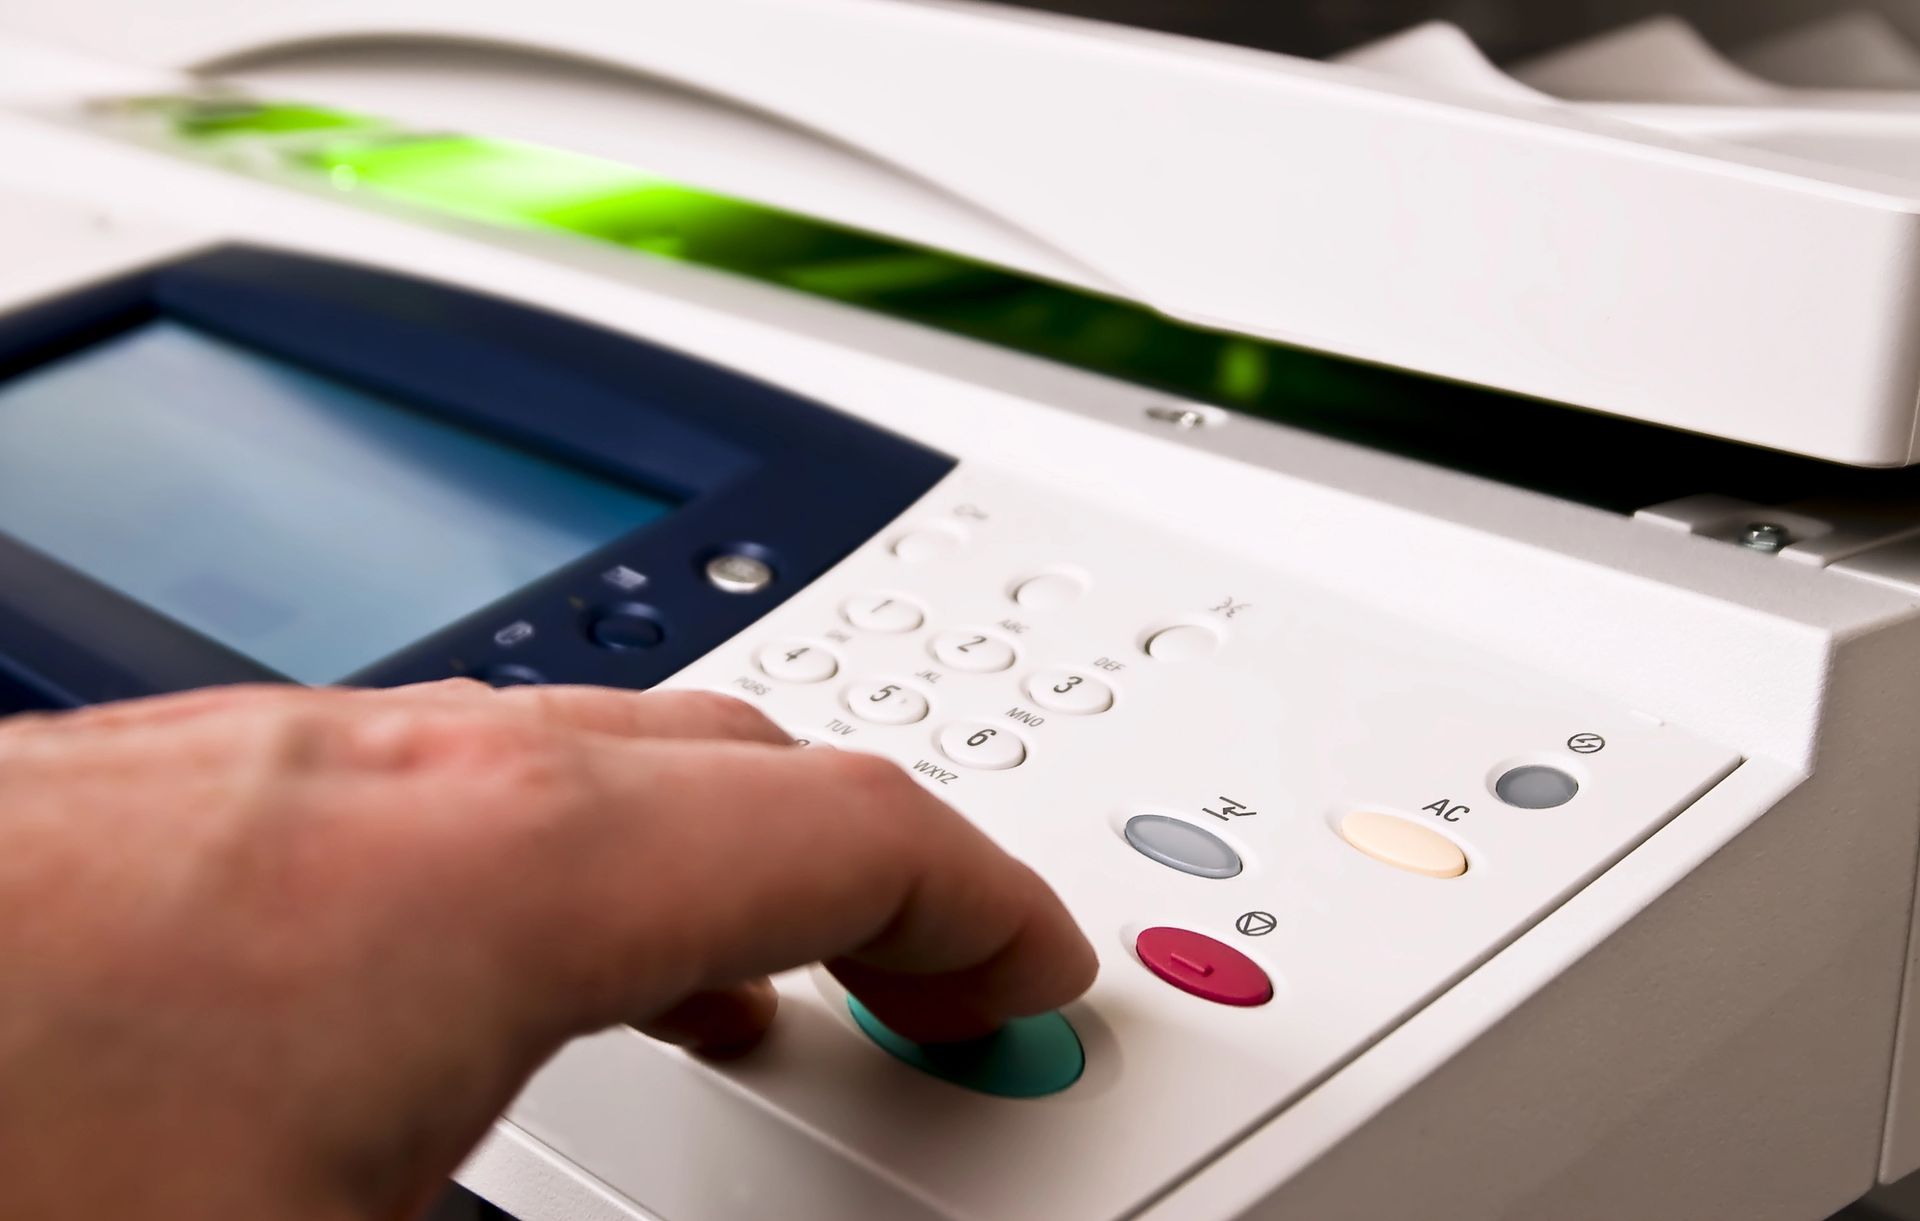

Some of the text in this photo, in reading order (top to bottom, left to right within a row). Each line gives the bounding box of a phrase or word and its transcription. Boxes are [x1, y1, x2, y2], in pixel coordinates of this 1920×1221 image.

[870, 599, 894, 614] 1
[956, 635, 987, 652] 2
[785, 647, 810, 662] 4
[1093, 656, 1126, 673] DEF
[914, 669, 942, 684] JKL
[1053, 676, 1083, 694] 3
[869, 685, 902, 702] 5
[1004, 707, 1045, 728] MNO
[824, 718, 857, 736] TUV
[966, 728, 997, 747] 6
[912, 759, 959, 785] WXYZ
[1421, 798, 1470, 822] AC
